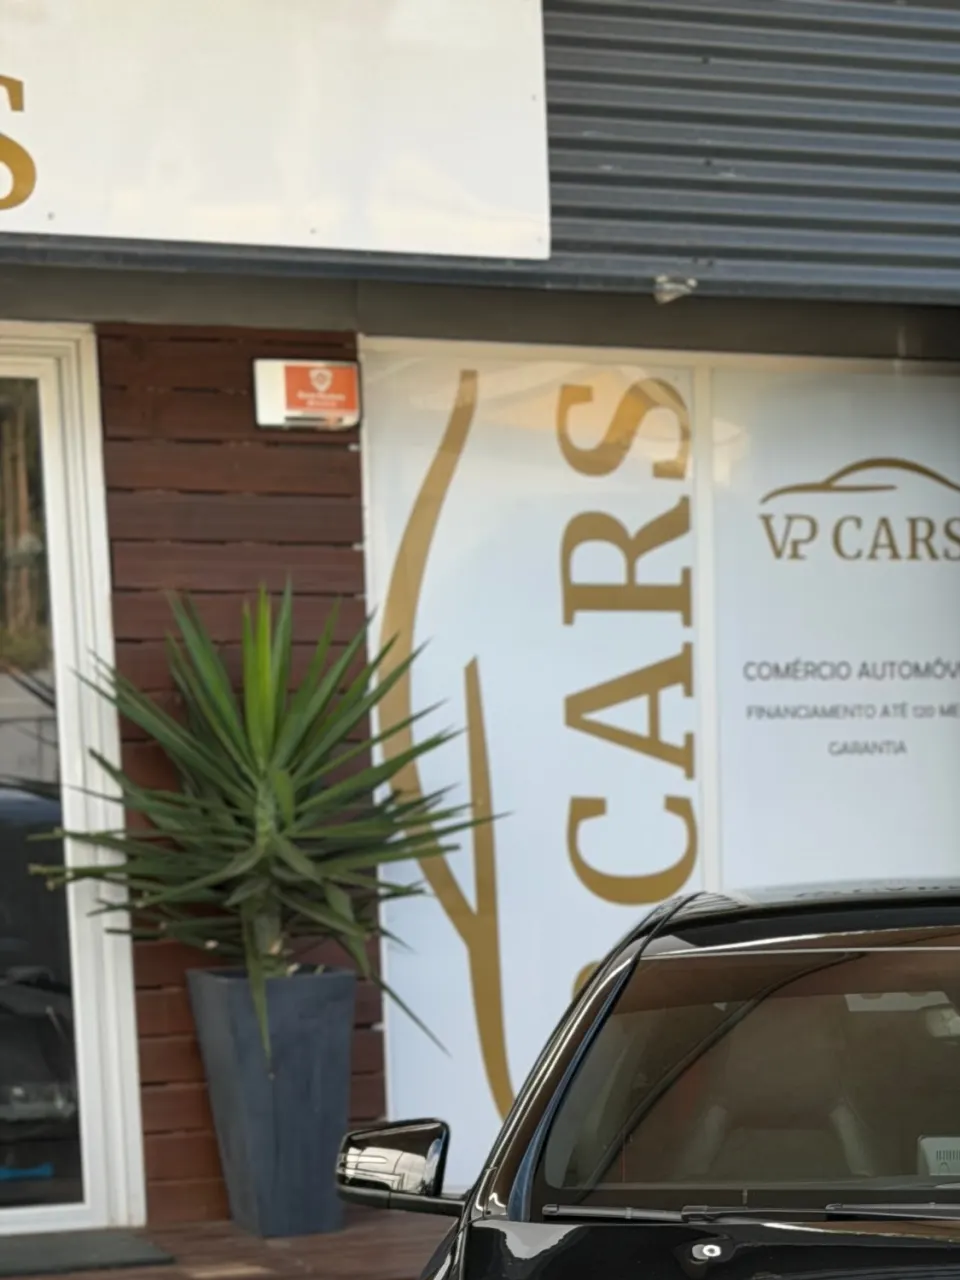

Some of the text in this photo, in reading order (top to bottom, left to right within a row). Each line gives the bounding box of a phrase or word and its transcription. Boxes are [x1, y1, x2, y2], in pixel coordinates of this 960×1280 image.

[759, 514, 818, 560] VP
[556, 377, 698, 905] CARS
[742, 657, 852, 682] COMÉRCIO
[746, 703, 877, 720] FINANCIAMENTO
[880, 700, 908, 719] ATÉ
[828, 741, 907, 756] GARANTIA
